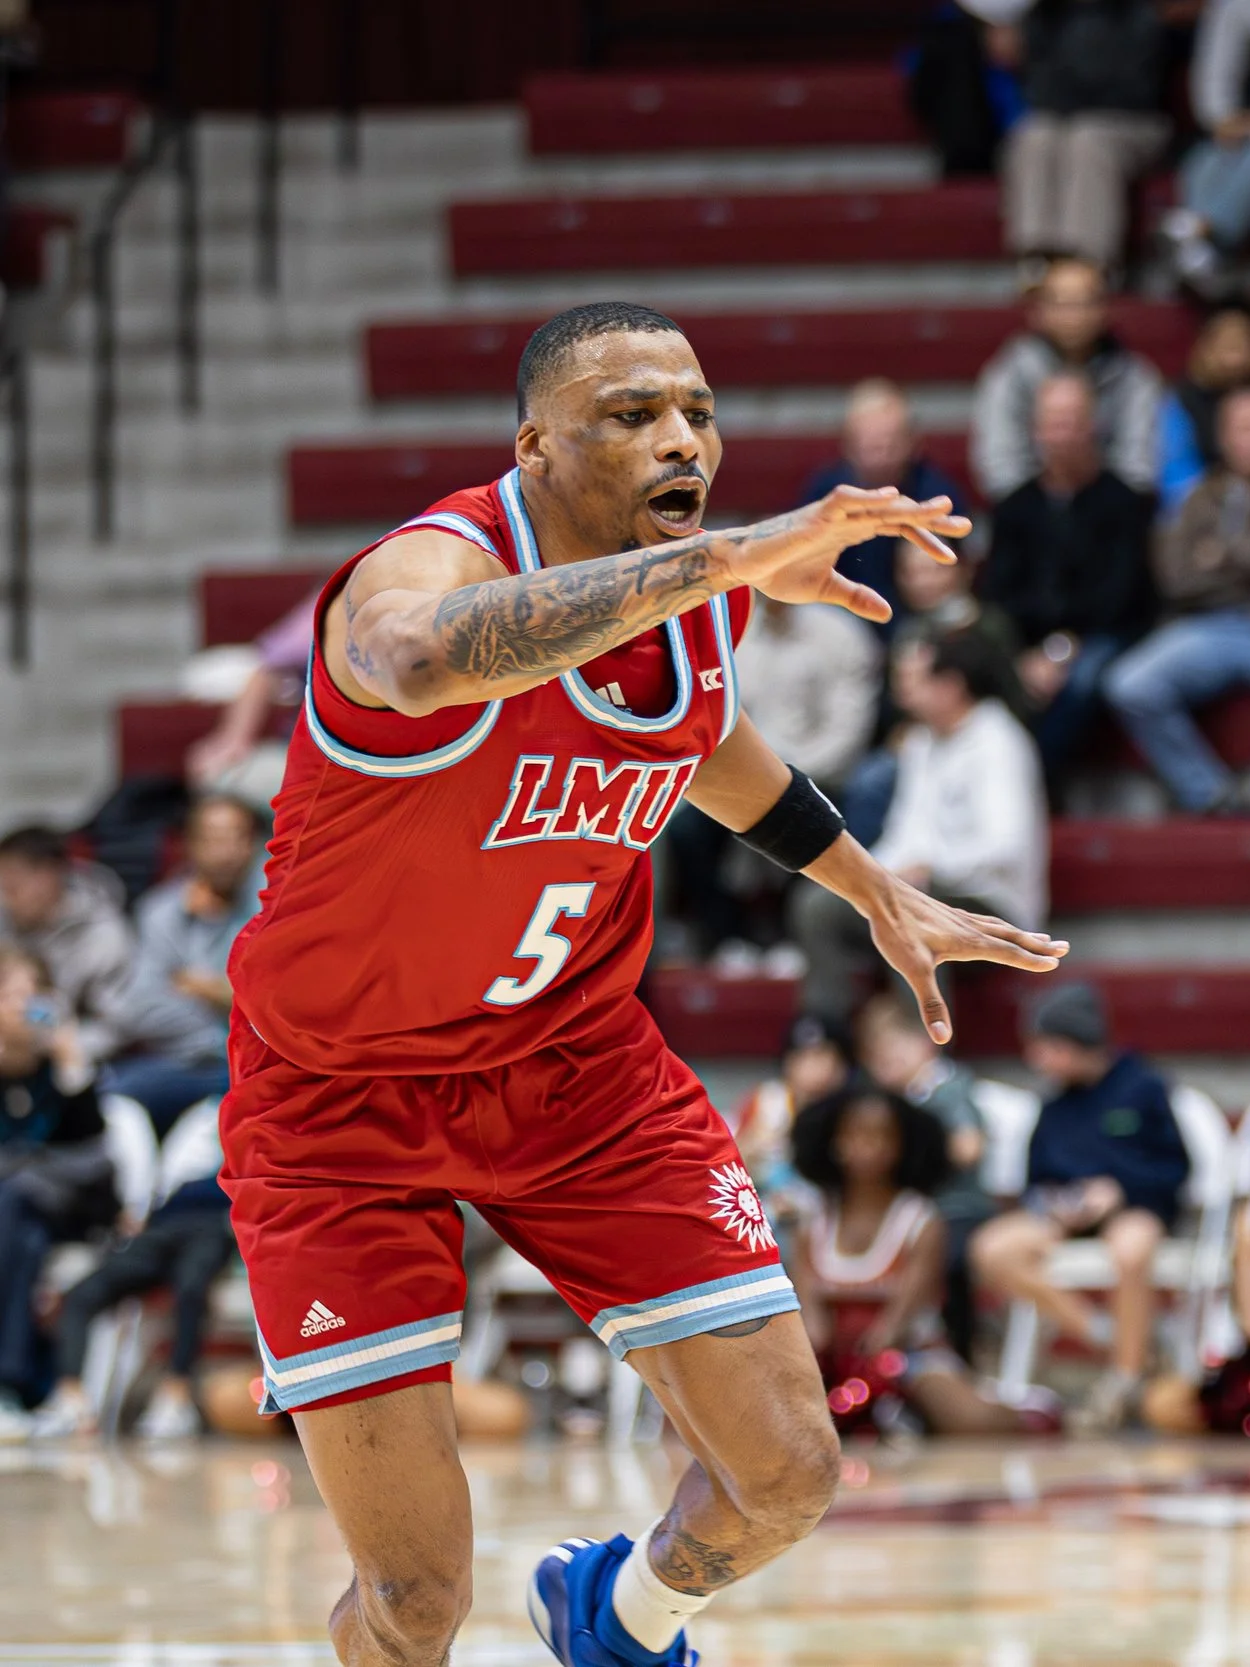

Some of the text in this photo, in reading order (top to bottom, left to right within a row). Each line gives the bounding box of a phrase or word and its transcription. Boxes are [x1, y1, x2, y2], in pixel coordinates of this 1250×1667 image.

[480, 754, 702, 851] LMU
[482, 882, 597, 1006] 5
[300, 1315, 346, 1338] adidas
